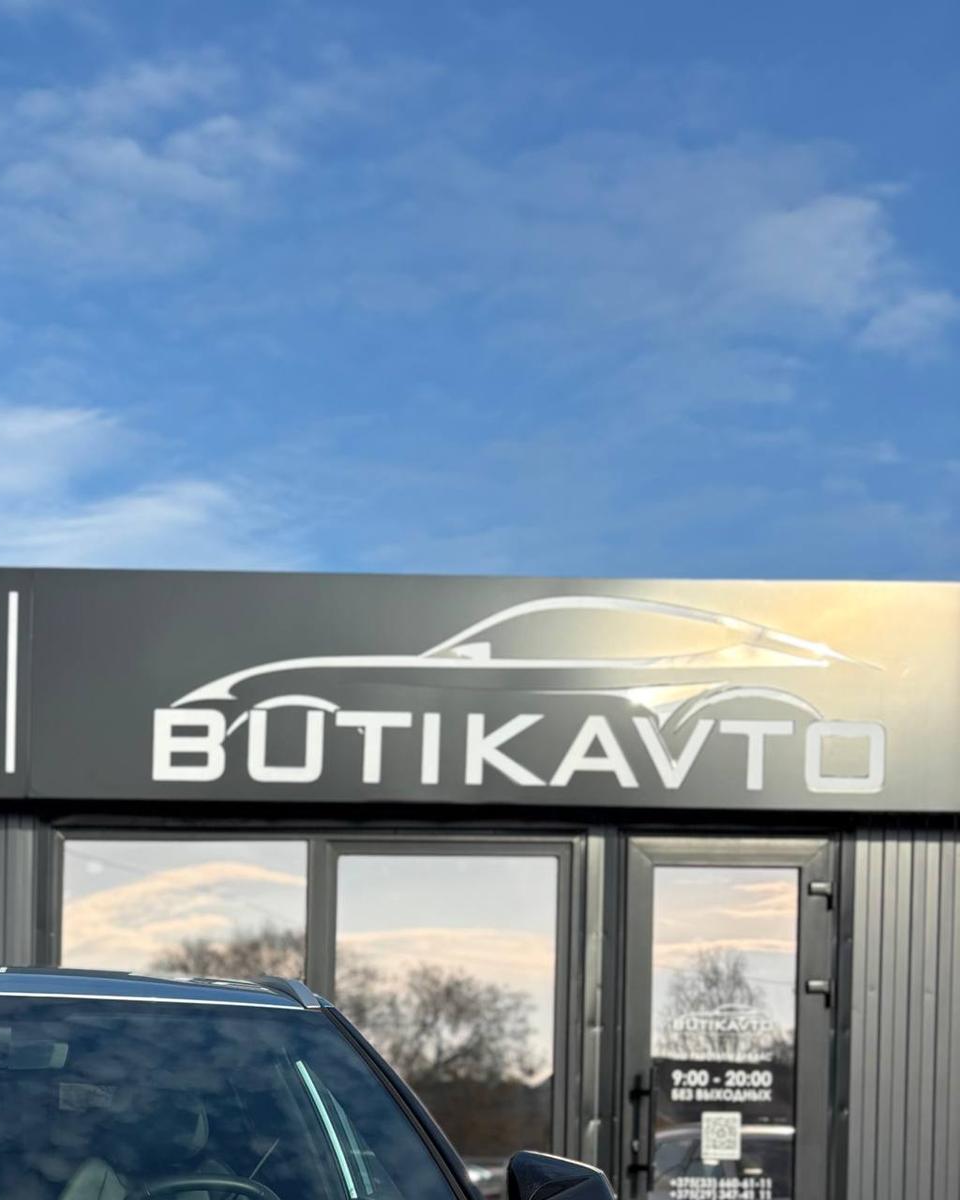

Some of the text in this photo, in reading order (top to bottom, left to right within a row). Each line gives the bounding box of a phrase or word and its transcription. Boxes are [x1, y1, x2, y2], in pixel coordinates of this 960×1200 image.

[152, 707, 887, 794] BUTIKAVTO
[671, 1069, 710, 1087] 9:00
[724, 1070, 773, 1088] 20:00
[671, 1088, 772, 1102] БЕЗ ВЫХОДНЫХ
